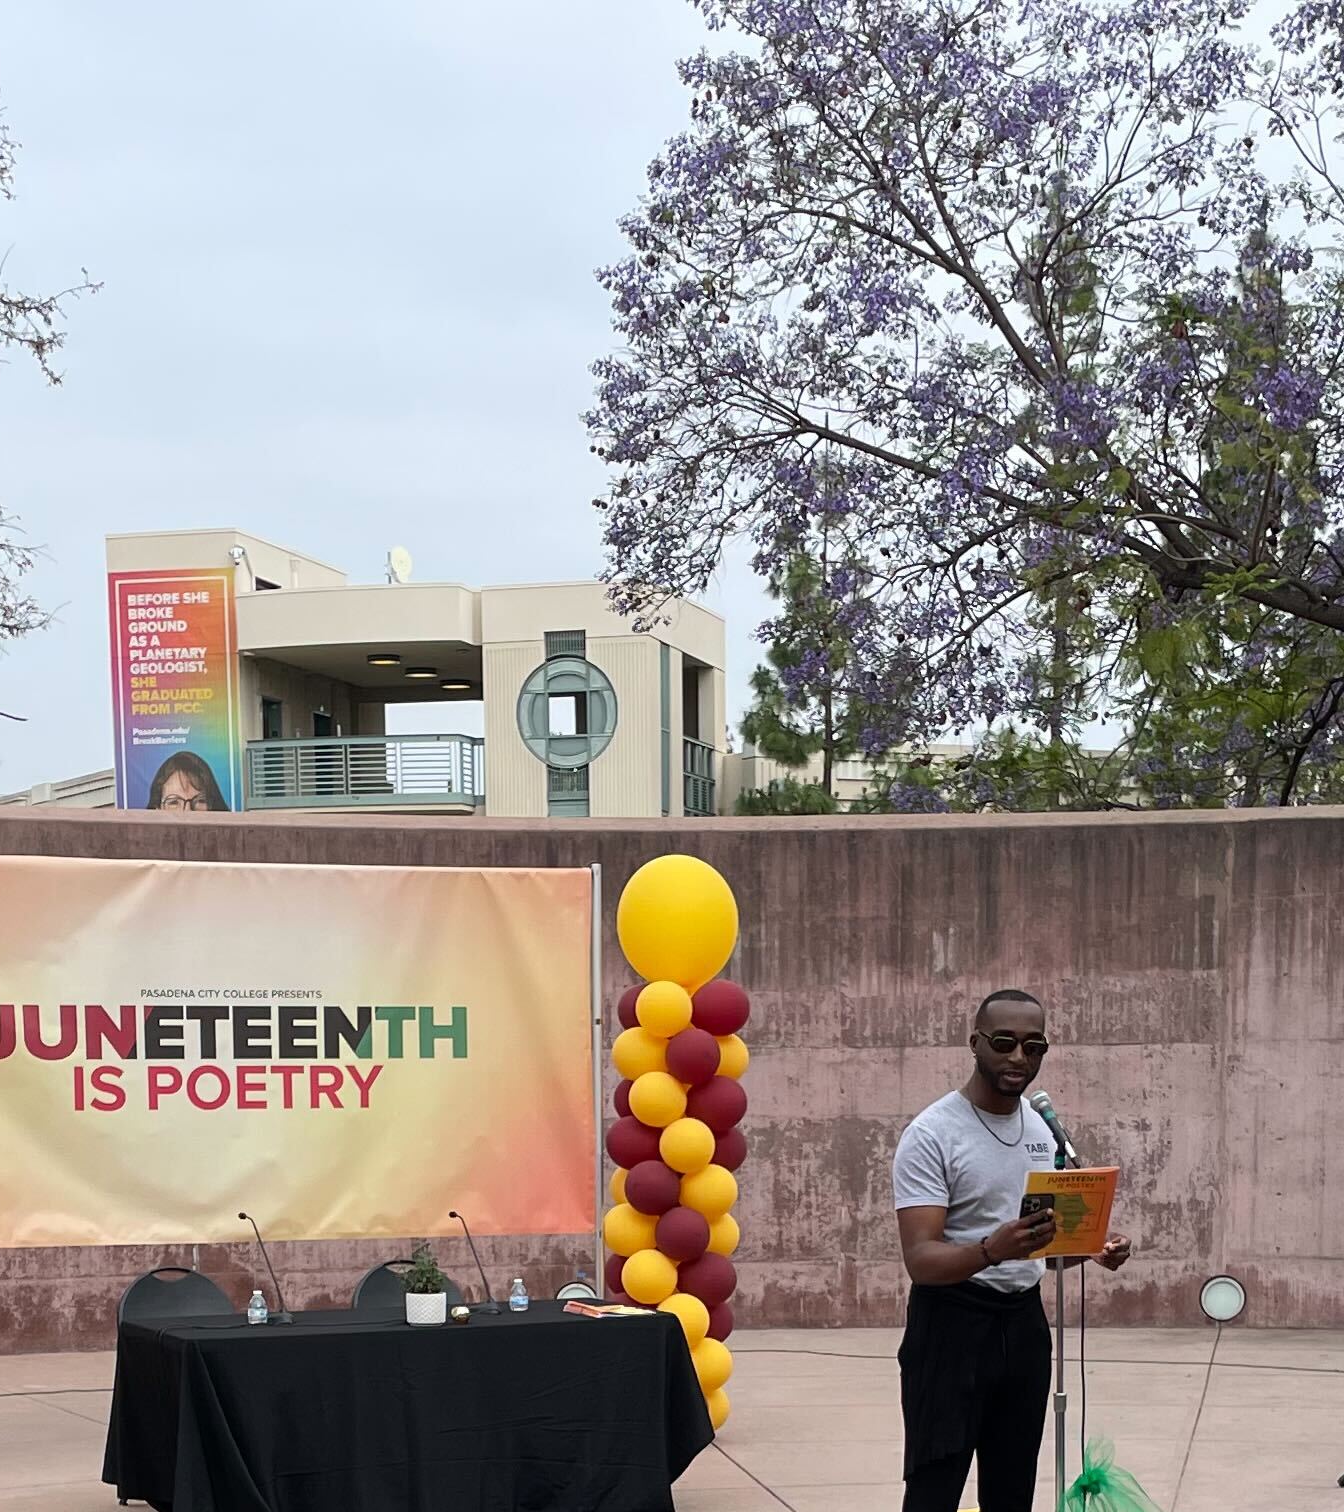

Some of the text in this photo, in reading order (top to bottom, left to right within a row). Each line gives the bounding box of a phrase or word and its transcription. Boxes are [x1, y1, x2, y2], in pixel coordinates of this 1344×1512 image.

[127, 591, 210, 606] BEFORE SHE
[127, 607, 174, 620] BROKE
[128, 620, 188, 634] GROUND
[128, 634, 161, 648] AS A
[129, 647, 208, 661] PLANETARY
[130, 660, 208, 675] GEOLOGIST,
[130, 676, 157, 688] SHE
[131, 687, 214, 702] GRADUATED
[132, 703, 170, 716] FROM
[140, 988, 323, 999] PASADENA CITY COLLEGE PRESENTS
[73, 1064, 384, 1112] IS POETRY
